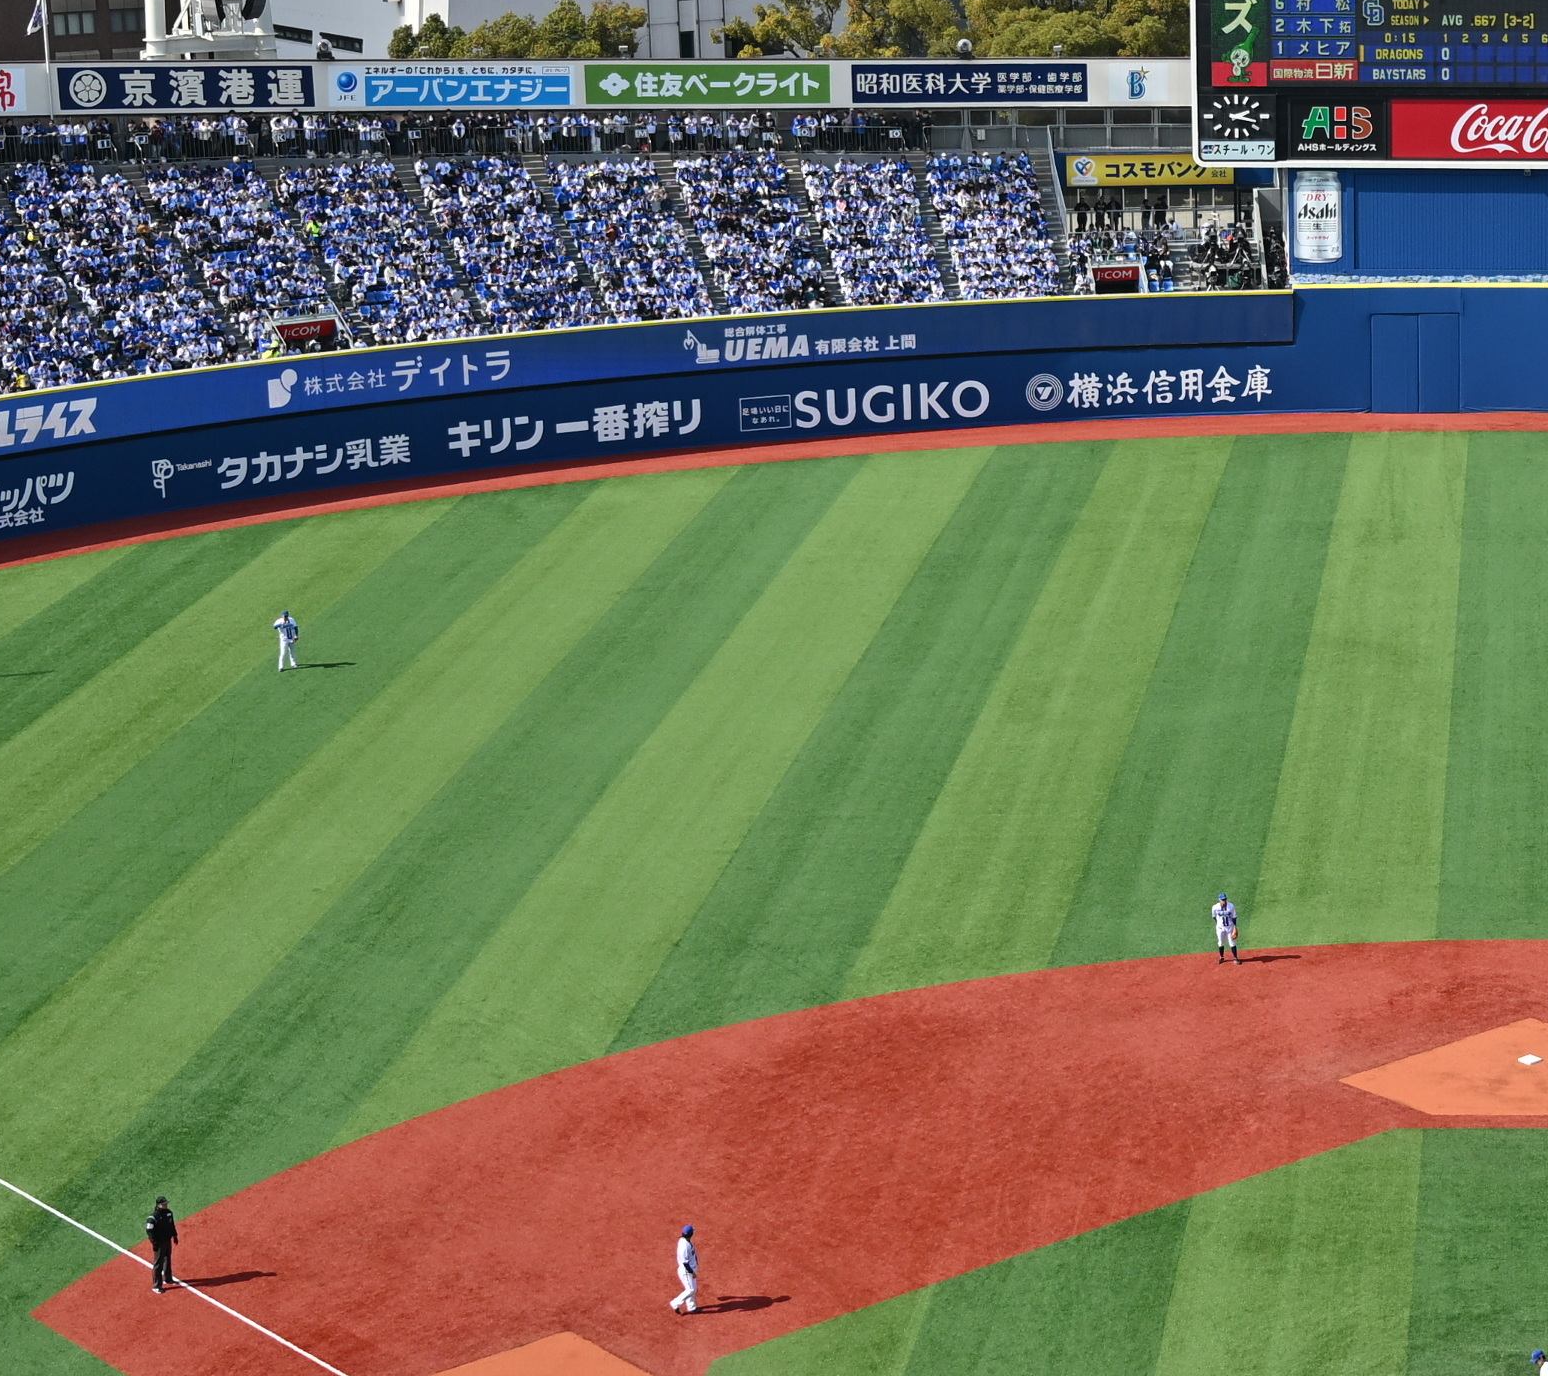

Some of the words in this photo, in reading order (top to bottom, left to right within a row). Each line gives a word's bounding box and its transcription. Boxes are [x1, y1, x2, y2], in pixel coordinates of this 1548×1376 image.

[1392, 0, 1420, 10] TODAY
[1390, 15, 1420, 26] SEASON
[1442, 15, 1463, 26] AVG
[1375, 48, 1423, 60] DRAGONS
[635, 72, 821, 98] 住友ベークライト
[856, 72, 992, 95] 昭和医科大学
[1372, 68, 1426, 80] BAYSTARS
[119, 69, 307, 108] 京濱港運
[371, 78, 568, 103] アーバンエナジー
[1213, 143, 1276, 157] スチール・ワン
[1298, 143, 1377, 153] AHSホールディングス
[1298, 202, 1337, 220] Asahi
[724, 324, 787, 338] 総合解体工事
[724, 335, 811, 362] UEMA
[814, 337, 880, 355] 有限会社
[303, 369, 387, 397] 株式会社
[1067, 363, 1274, 410] 横浜信用金庫
[795, 380, 991, 429] SUGIKO
[447, 420, 546, 458] キリン
[555, 398, 704, 444] 一番搾り
[217, 434, 412, 490] タカナシ乳業
